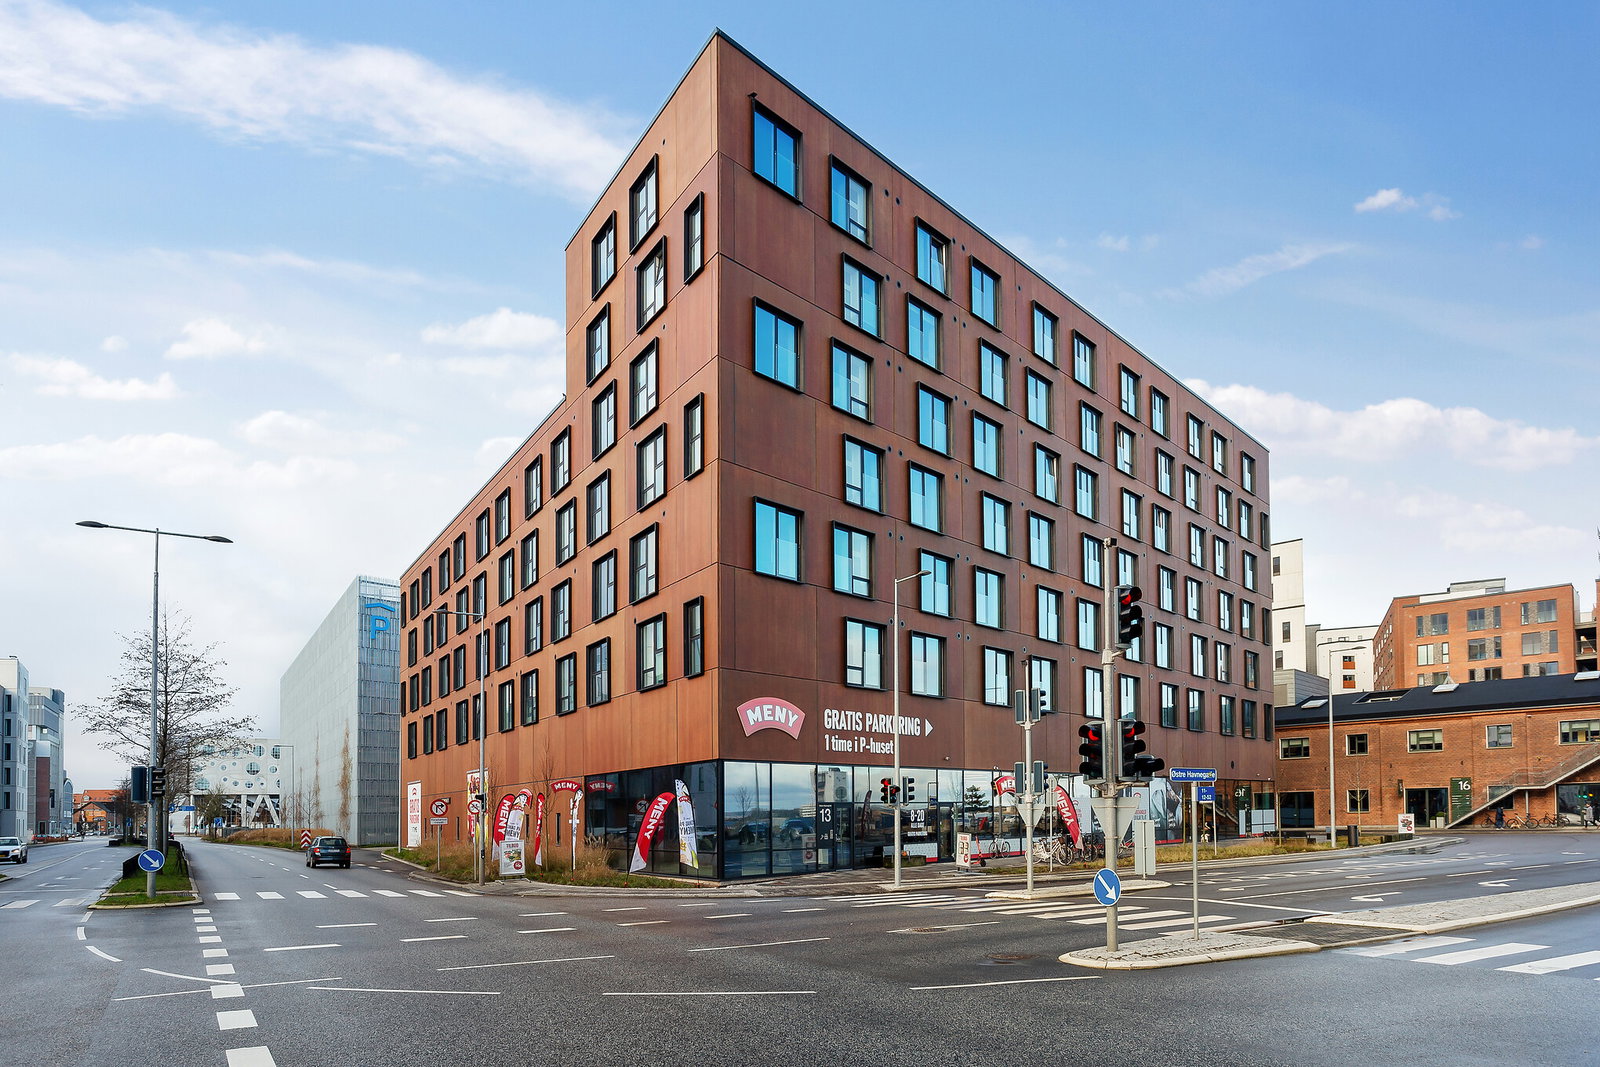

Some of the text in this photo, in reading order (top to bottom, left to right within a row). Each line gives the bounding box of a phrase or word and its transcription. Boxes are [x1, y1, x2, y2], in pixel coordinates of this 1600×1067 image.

[370, 616, 390, 639] P
[746, 704, 799, 727] MENY
[824, 708, 862, 731] GRATIS
[824, 734, 894, 754] 1 time i P-huset
[1171, 770, 1186, 779] Østre
[553, 782, 578, 790] MENY
[1458, 780, 1471, 791] 16
[498, 799, 511, 837] MENY
[644, 797, 668, 840] MENY
[819, 808, 832, 823] 13
[910, 809, 925, 822] 8-20
